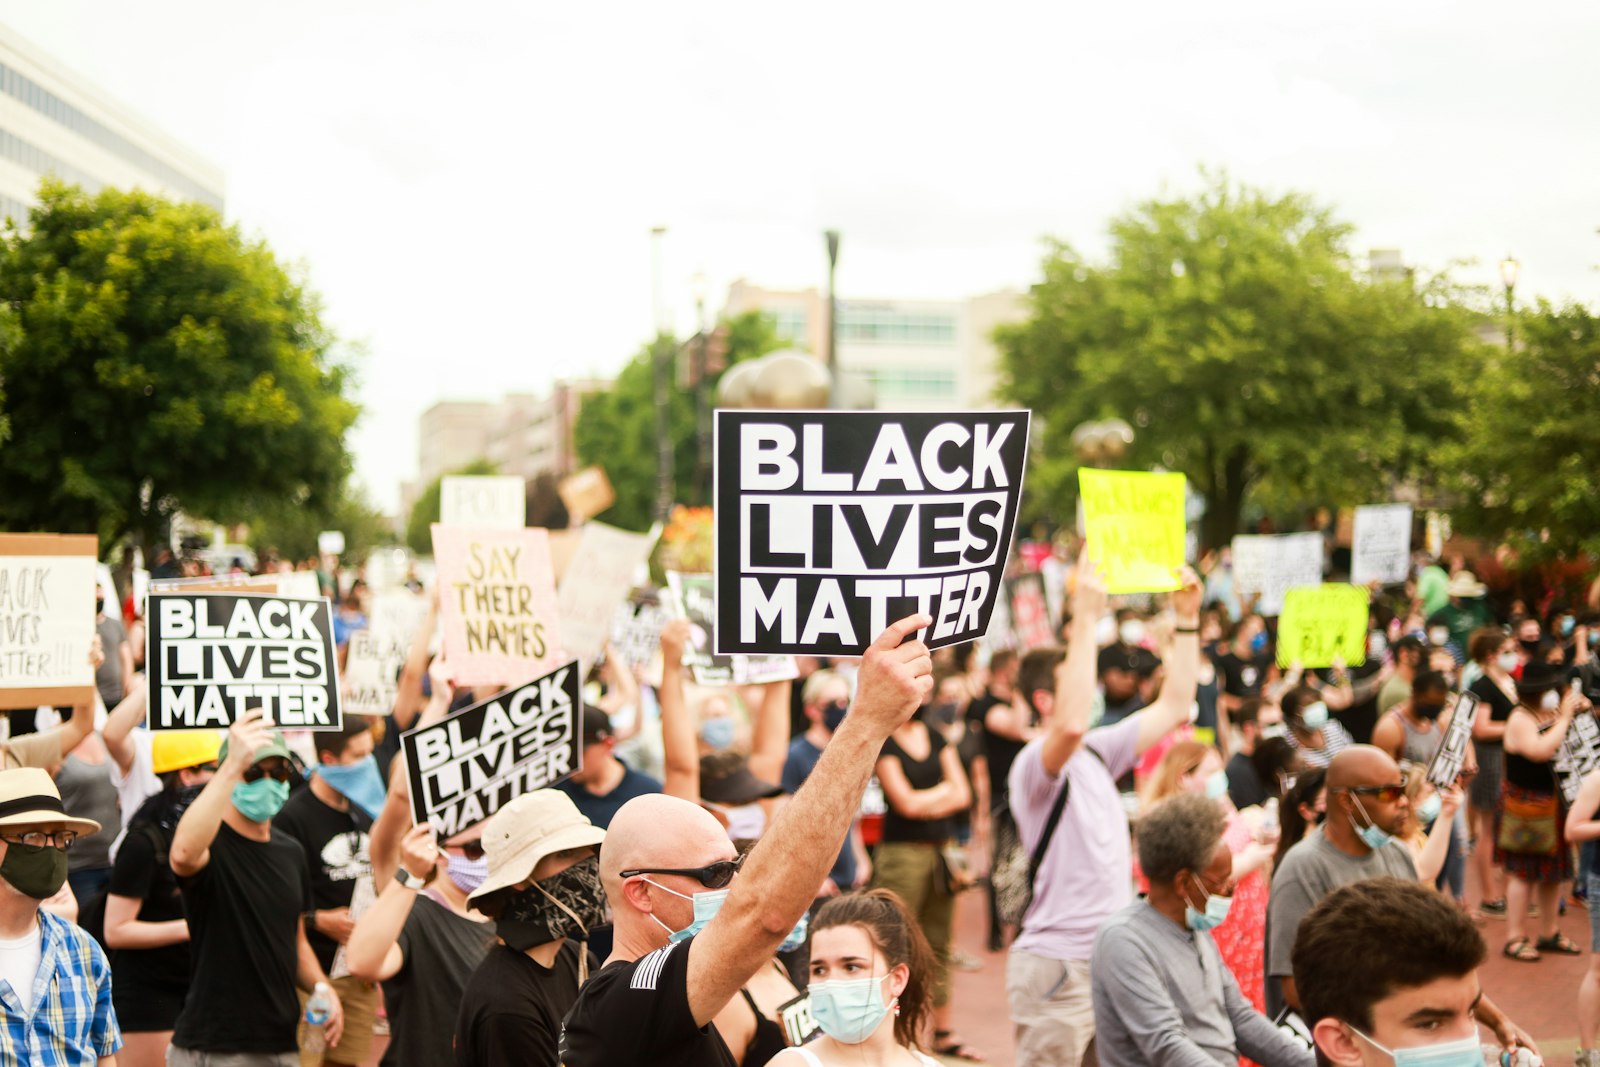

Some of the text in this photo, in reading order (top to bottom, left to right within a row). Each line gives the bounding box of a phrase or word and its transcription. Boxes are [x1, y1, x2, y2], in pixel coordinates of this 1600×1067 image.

[740, 422, 1014, 492] BLACK
[467, 543, 520, 581] SAY
[750, 500, 1002, 570] LIVES
[160, 599, 323, 639] BLACK
[453, 582, 532, 617] THEIR
[740, 570, 990, 646] MATTER
[167, 646, 322, 680] LIVES
[466, 619, 546, 659] NAMES
[161, 684, 331, 727] MATTER
[415, 667, 572, 773] BLACK
[428, 711, 567, 808] LIVES
[427, 743, 572, 838] MATTER
